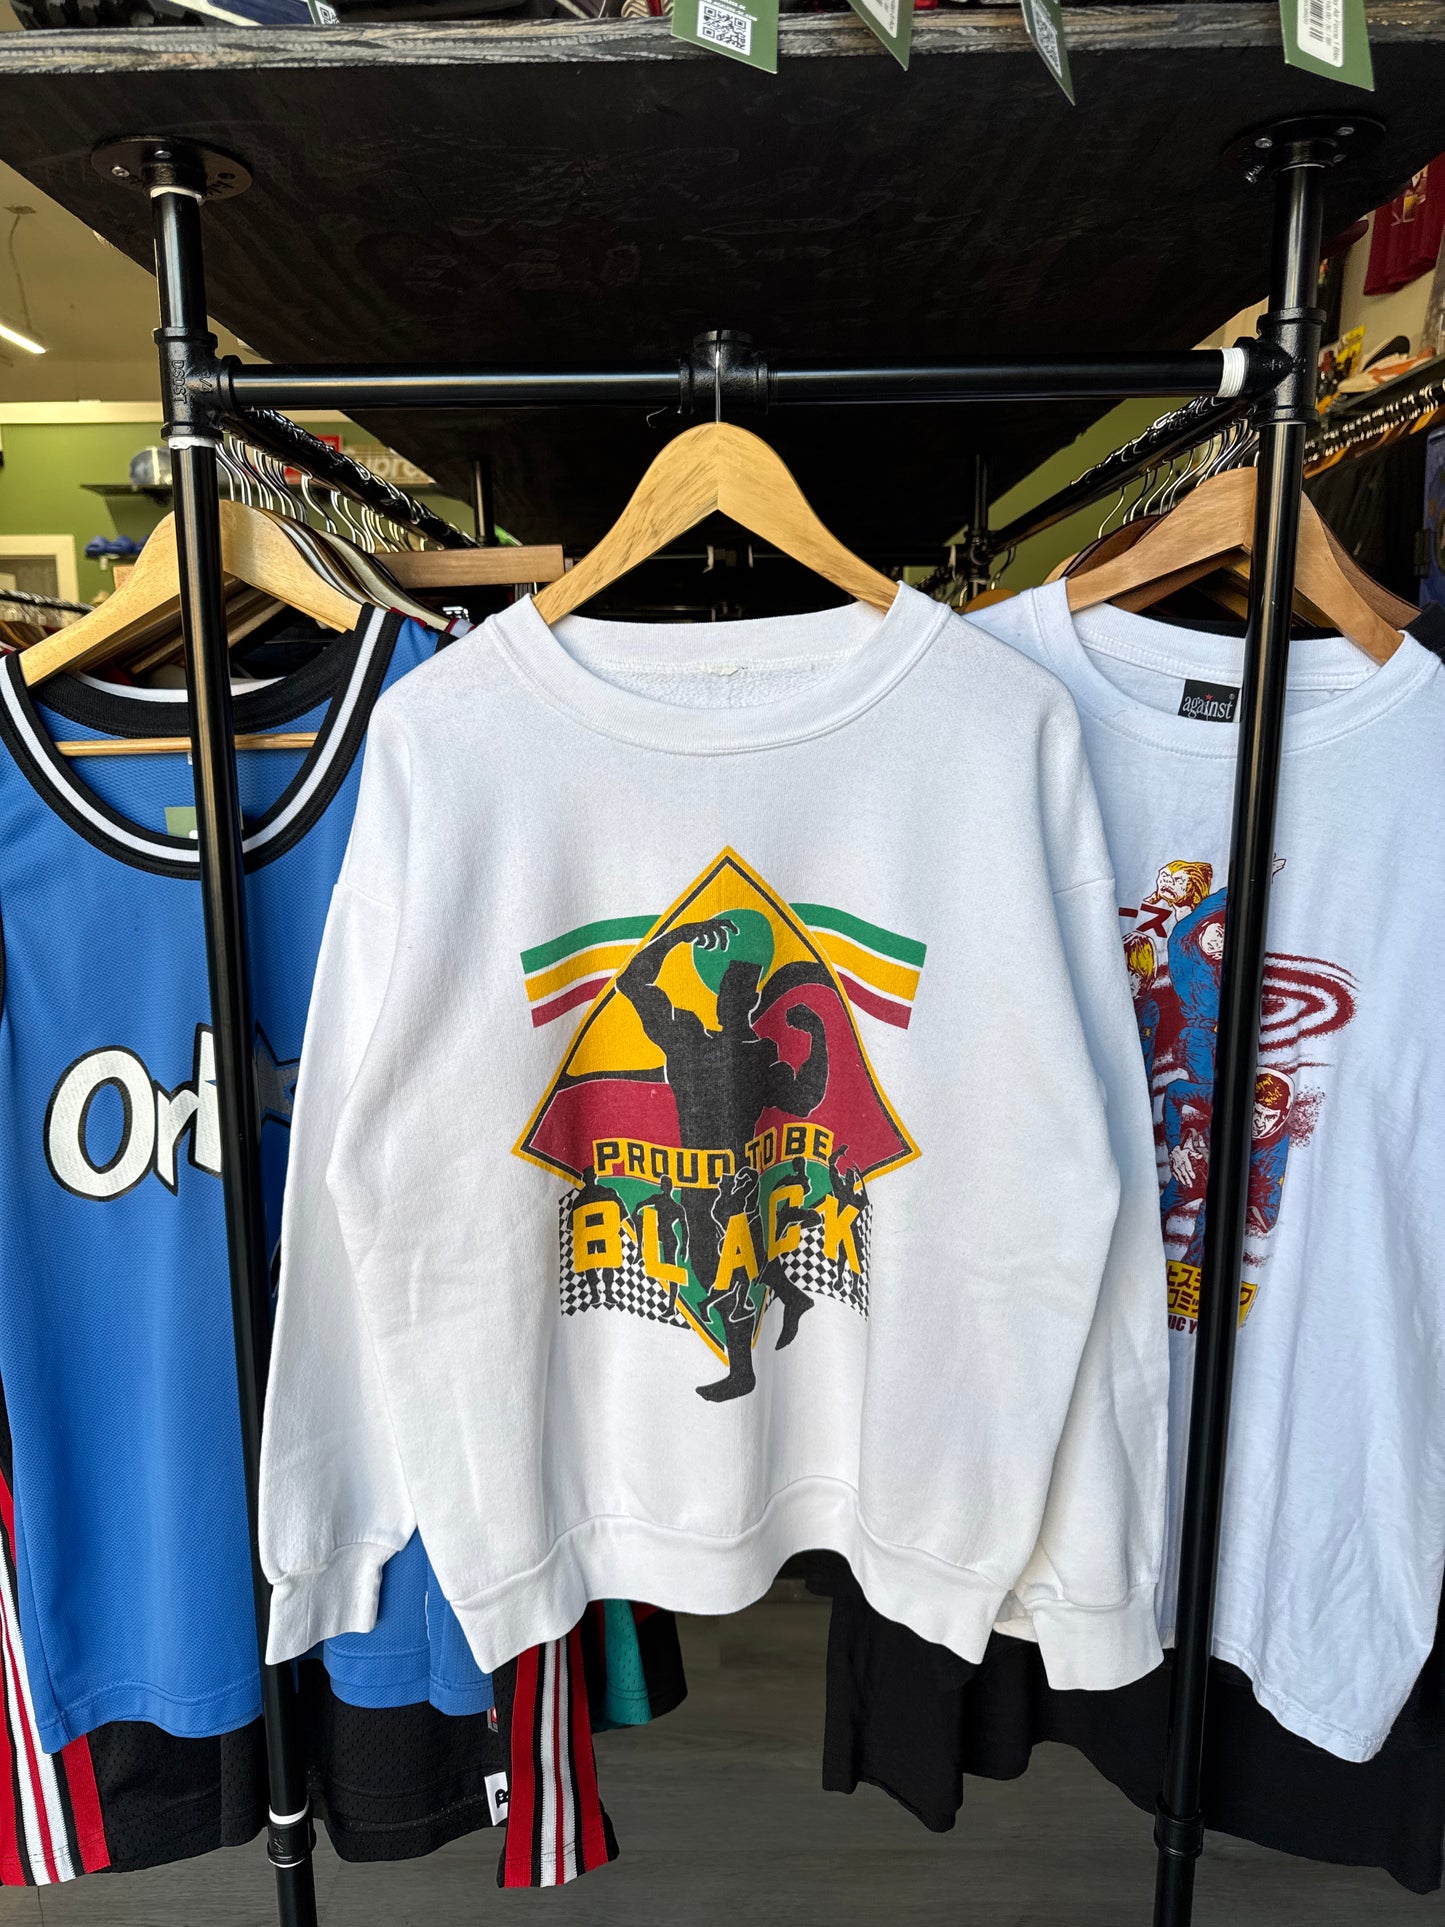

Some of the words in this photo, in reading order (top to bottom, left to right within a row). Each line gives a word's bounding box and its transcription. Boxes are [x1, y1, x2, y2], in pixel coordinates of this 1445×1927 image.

[1182, 696, 1233, 720] against
[784, 1126, 830, 1161] BE
[572, 1184, 862, 1290] BLACK
